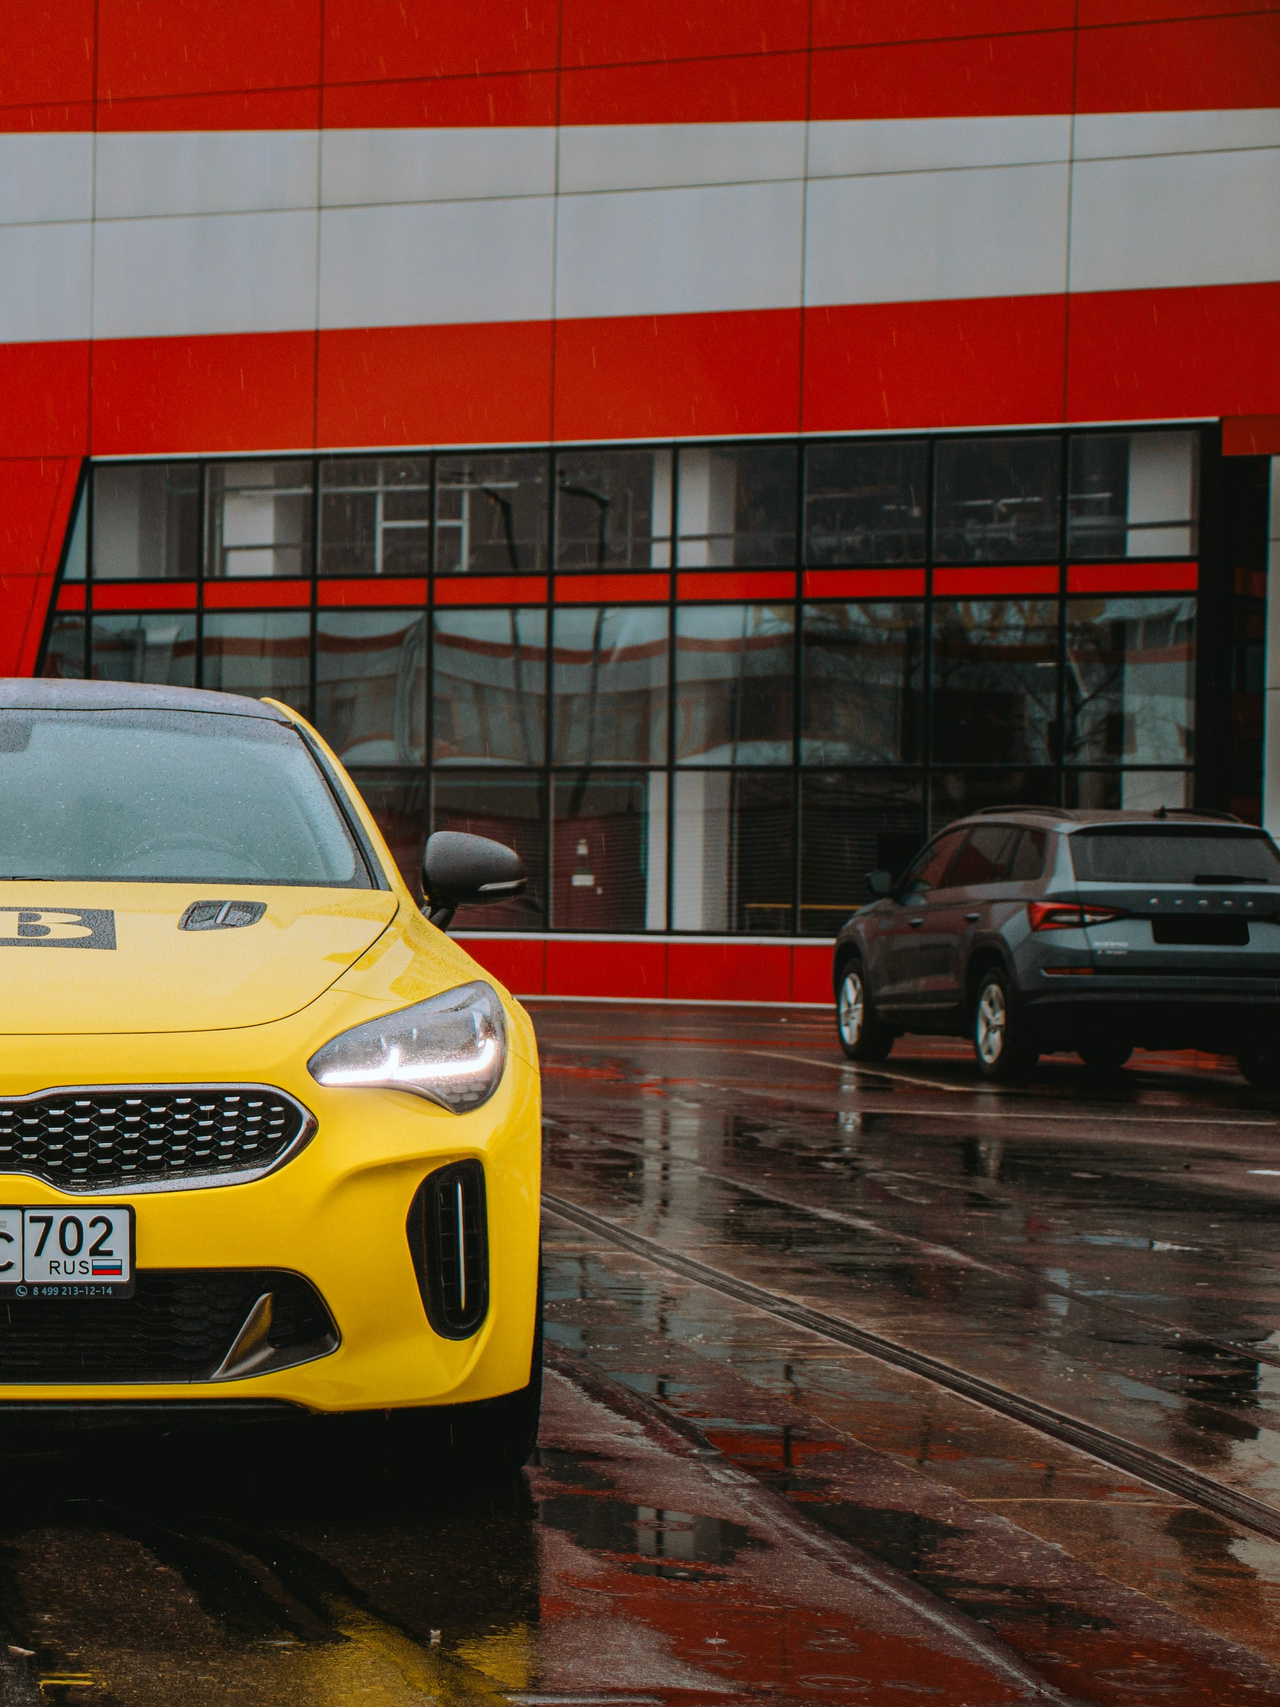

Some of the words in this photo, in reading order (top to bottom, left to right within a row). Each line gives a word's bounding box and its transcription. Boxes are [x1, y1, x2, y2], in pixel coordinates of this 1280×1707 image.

[28, 1214, 114, 1257] 702
[49, 1260, 90, 1275] RUS
[33, 1286, 39, 1296] 8
[41, 1286, 59, 1296] 499
[61, 1286, 113, 1296] 213-12-14
